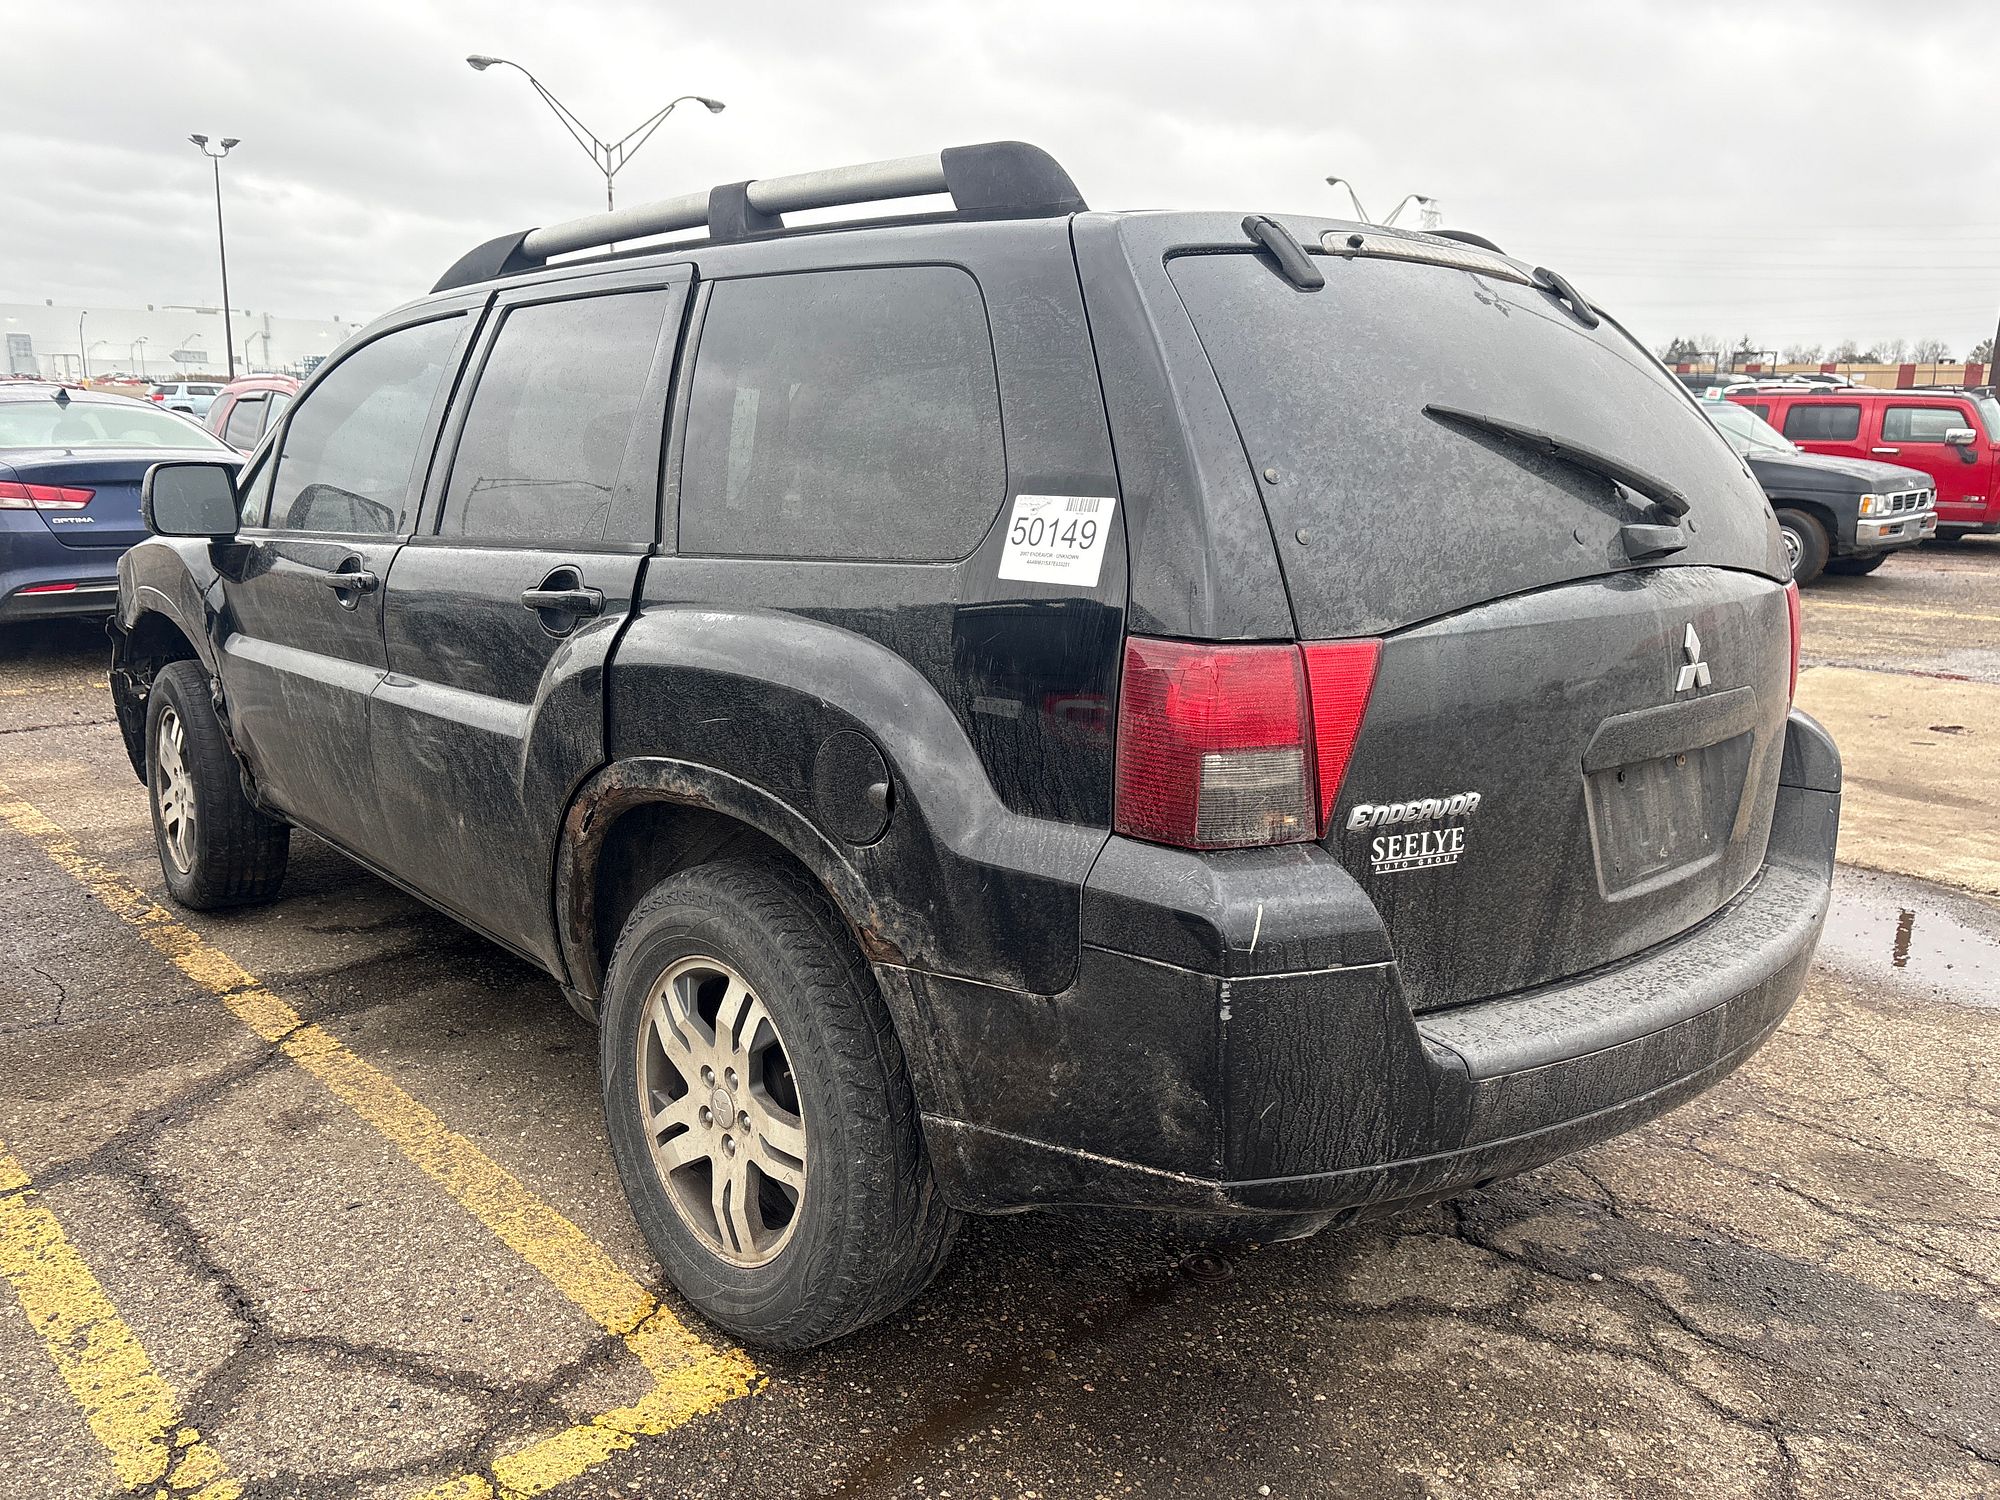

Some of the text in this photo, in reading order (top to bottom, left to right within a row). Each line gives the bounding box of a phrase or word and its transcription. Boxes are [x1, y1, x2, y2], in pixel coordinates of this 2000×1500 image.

[52, 516, 95, 524] OPTIMA
[1011, 517, 1097, 550] 50149
[1346, 791, 1482, 831] ENDEAVOR
[1370, 827, 1465, 862] SEELYE
[1375, 854, 1458, 871] AUTO GROUP
